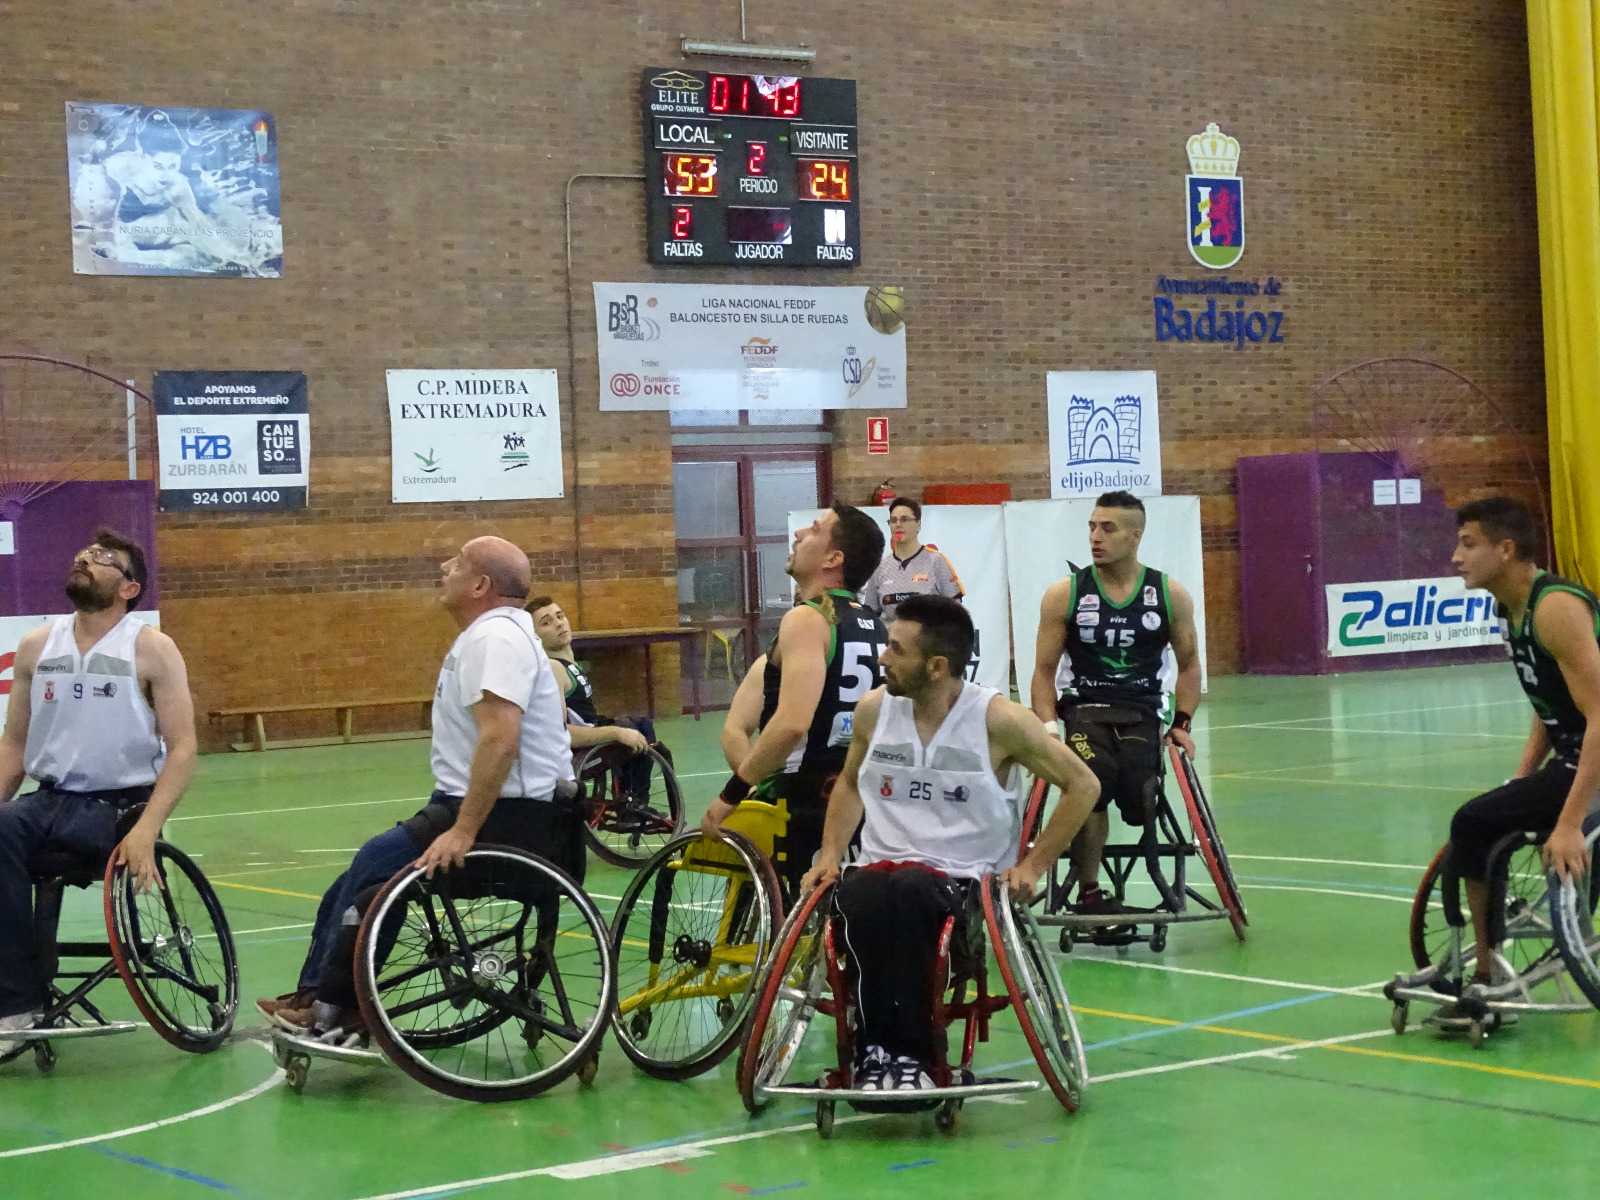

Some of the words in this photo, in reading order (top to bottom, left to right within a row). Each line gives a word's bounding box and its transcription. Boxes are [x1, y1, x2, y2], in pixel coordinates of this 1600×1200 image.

[658, 90, 699, 105] ELITE
[651, 104, 674, 112] GRUPO
[675, 105, 705, 114] OLYMPEX
[660, 125, 715, 144] LOCAL
[796, 132, 849, 150] VISITANTE
[749, 145, 764, 173] 2
[677, 157, 713, 193] 53
[812, 163, 847, 197] 24
[739, 179, 778, 193] PERIODO
[674, 208, 690, 237] 2
[119, 226, 150, 235] NURIA
[216, 228, 274, 239] PROVENCIO
[664, 242, 703, 257] FALTAS
[735, 244, 784, 259] JUGADOR
[817, 246, 854, 260] FALTAS
[1264, 277, 1282, 296] de
[702, 298, 726, 309] LIGA
[728, 299, 781, 310] NACIONAL
[783, 299, 817, 310] FEDDF
[670, 313, 741, 324] BALONCESTO
[744, 313, 758, 324] EN
[761, 313, 789, 324] SILLA
[791, 314, 806, 325] DE
[808, 314, 849, 325] RUEDAS
[1154, 296, 1284, 350] Badajoz
[740, 345, 779, 354] FEDDF
[842, 358, 861, 384] CSD
[643, 375, 681, 383] Fundación
[204, 385, 257, 394] APOYAMOS
[417, 379, 450, 396] C.P.
[455, 379, 529, 396] MIDEBA
[643, 384, 681, 395] ONCE
[173, 397, 186, 405] EL
[187, 397, 231, 405] DEPORTE
[233, 395, 290, 405] EXTREMEÑO
[401, 402, 547, 419] EXTREMADURA
[180, 426, 206, 434] HOTEL
[262, 424, 294, 436] CAN
[181, 435, 232, 460] HZB
[262, 437, 295, 449] TUE
[168, 461, 247, 476] ZURBARÁN
[402, 475, 457, 485] Extremadura
[192, 492, 219, 504] 924
[222, 491, 248, 503] 001
[252, 491, 280, 502] 400
[1104, 629, 1135, 648] 15
[1386, 630, 1429, 644] limpieza
[1435, 632, 1442, 642] y
[1447, 626, 1488, 640] jardines
[73, 682, 83, 699] 9
[909, 781, 932, 800] 25
